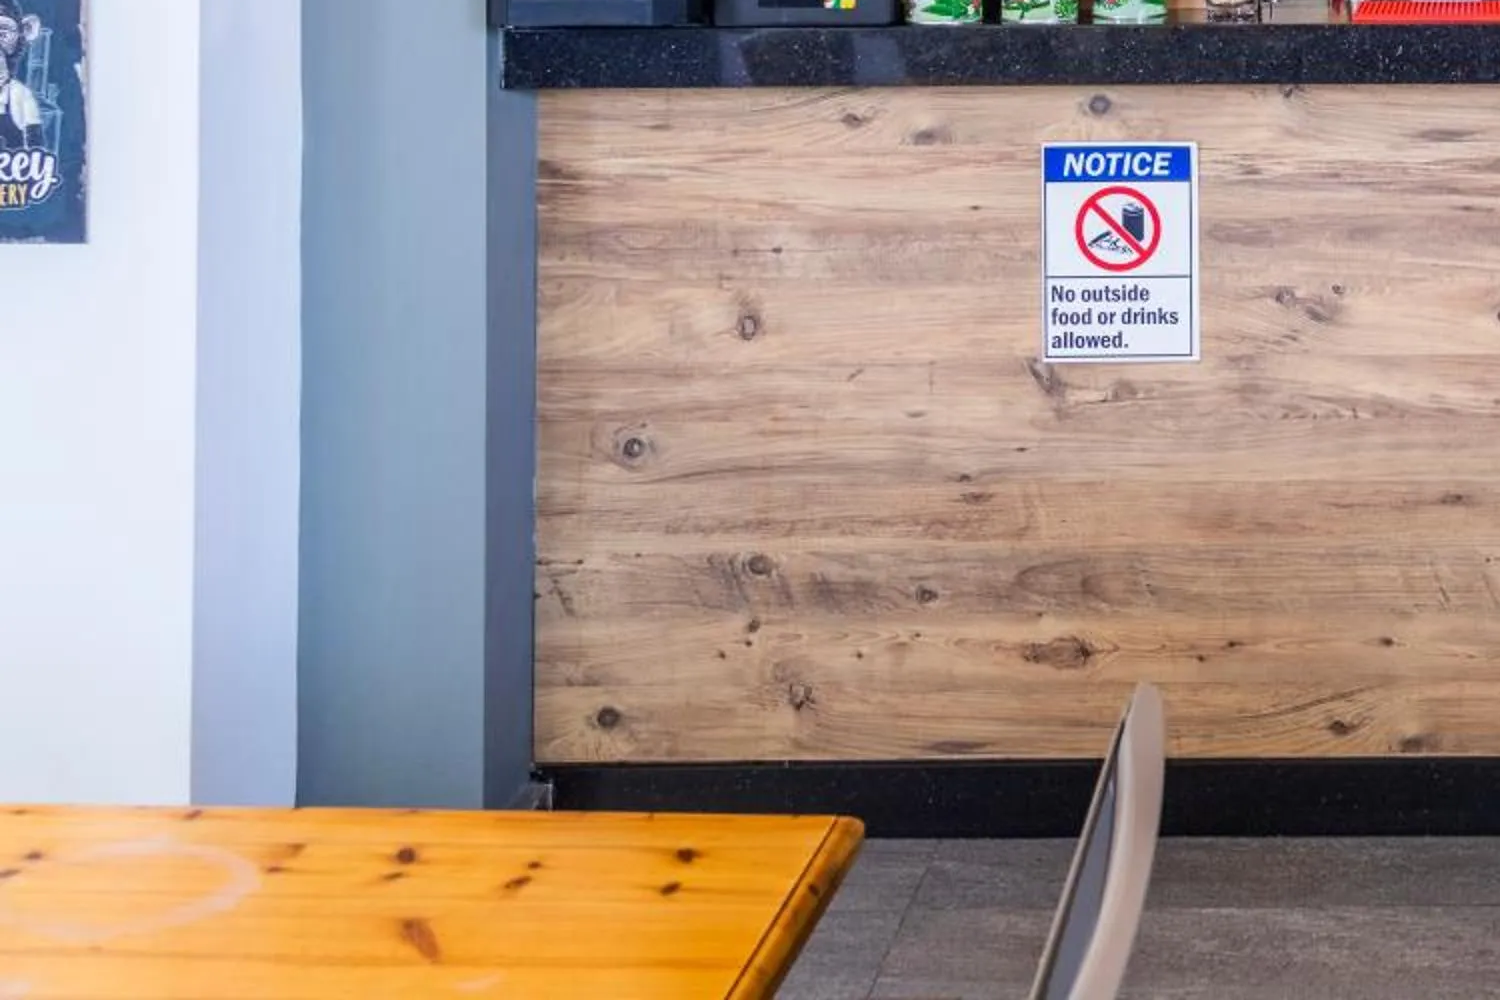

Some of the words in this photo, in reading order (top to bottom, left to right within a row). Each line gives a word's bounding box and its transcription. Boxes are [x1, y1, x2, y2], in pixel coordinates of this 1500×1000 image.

[1063, 151, 1173, 177] NOTICE
[1051, 285, 1076, 302] No
[1081, 284, 1150, 302] outside
[1051, 307, 1092, 325] food
[1097, 311, 1116, 325] or
[1121, 307, 1179, 325] drinks
[1051, 331, 1129, 349] allowed.
